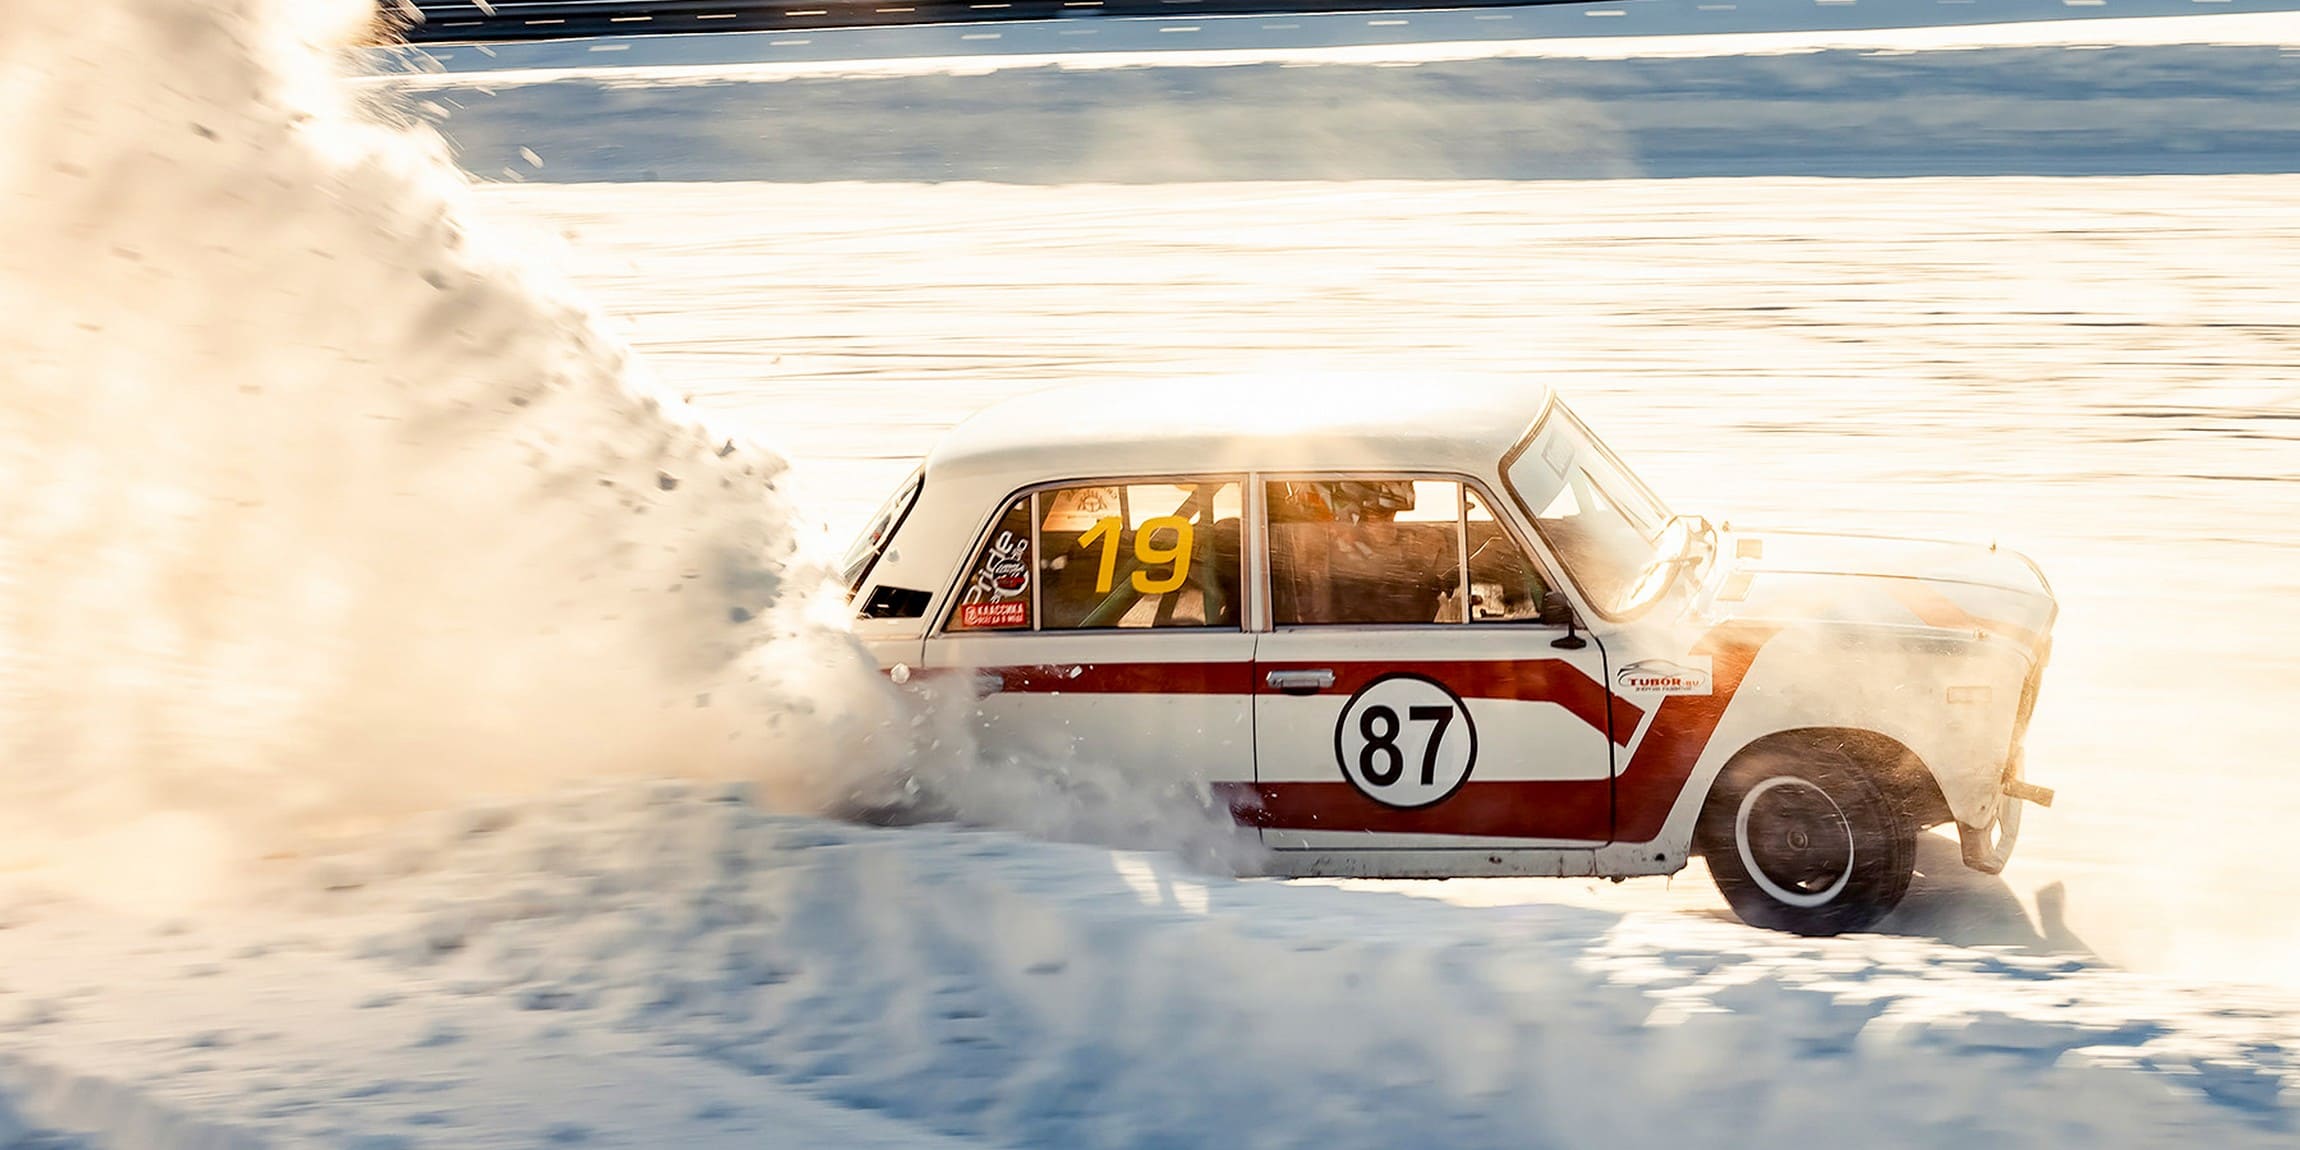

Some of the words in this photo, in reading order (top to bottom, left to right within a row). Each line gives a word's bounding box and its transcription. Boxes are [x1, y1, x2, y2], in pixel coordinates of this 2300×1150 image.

[962, 530, 1014, 606] Pride
[1077, 515, 1194, 595] 19
[1359, 704, 1454, 787] 87
